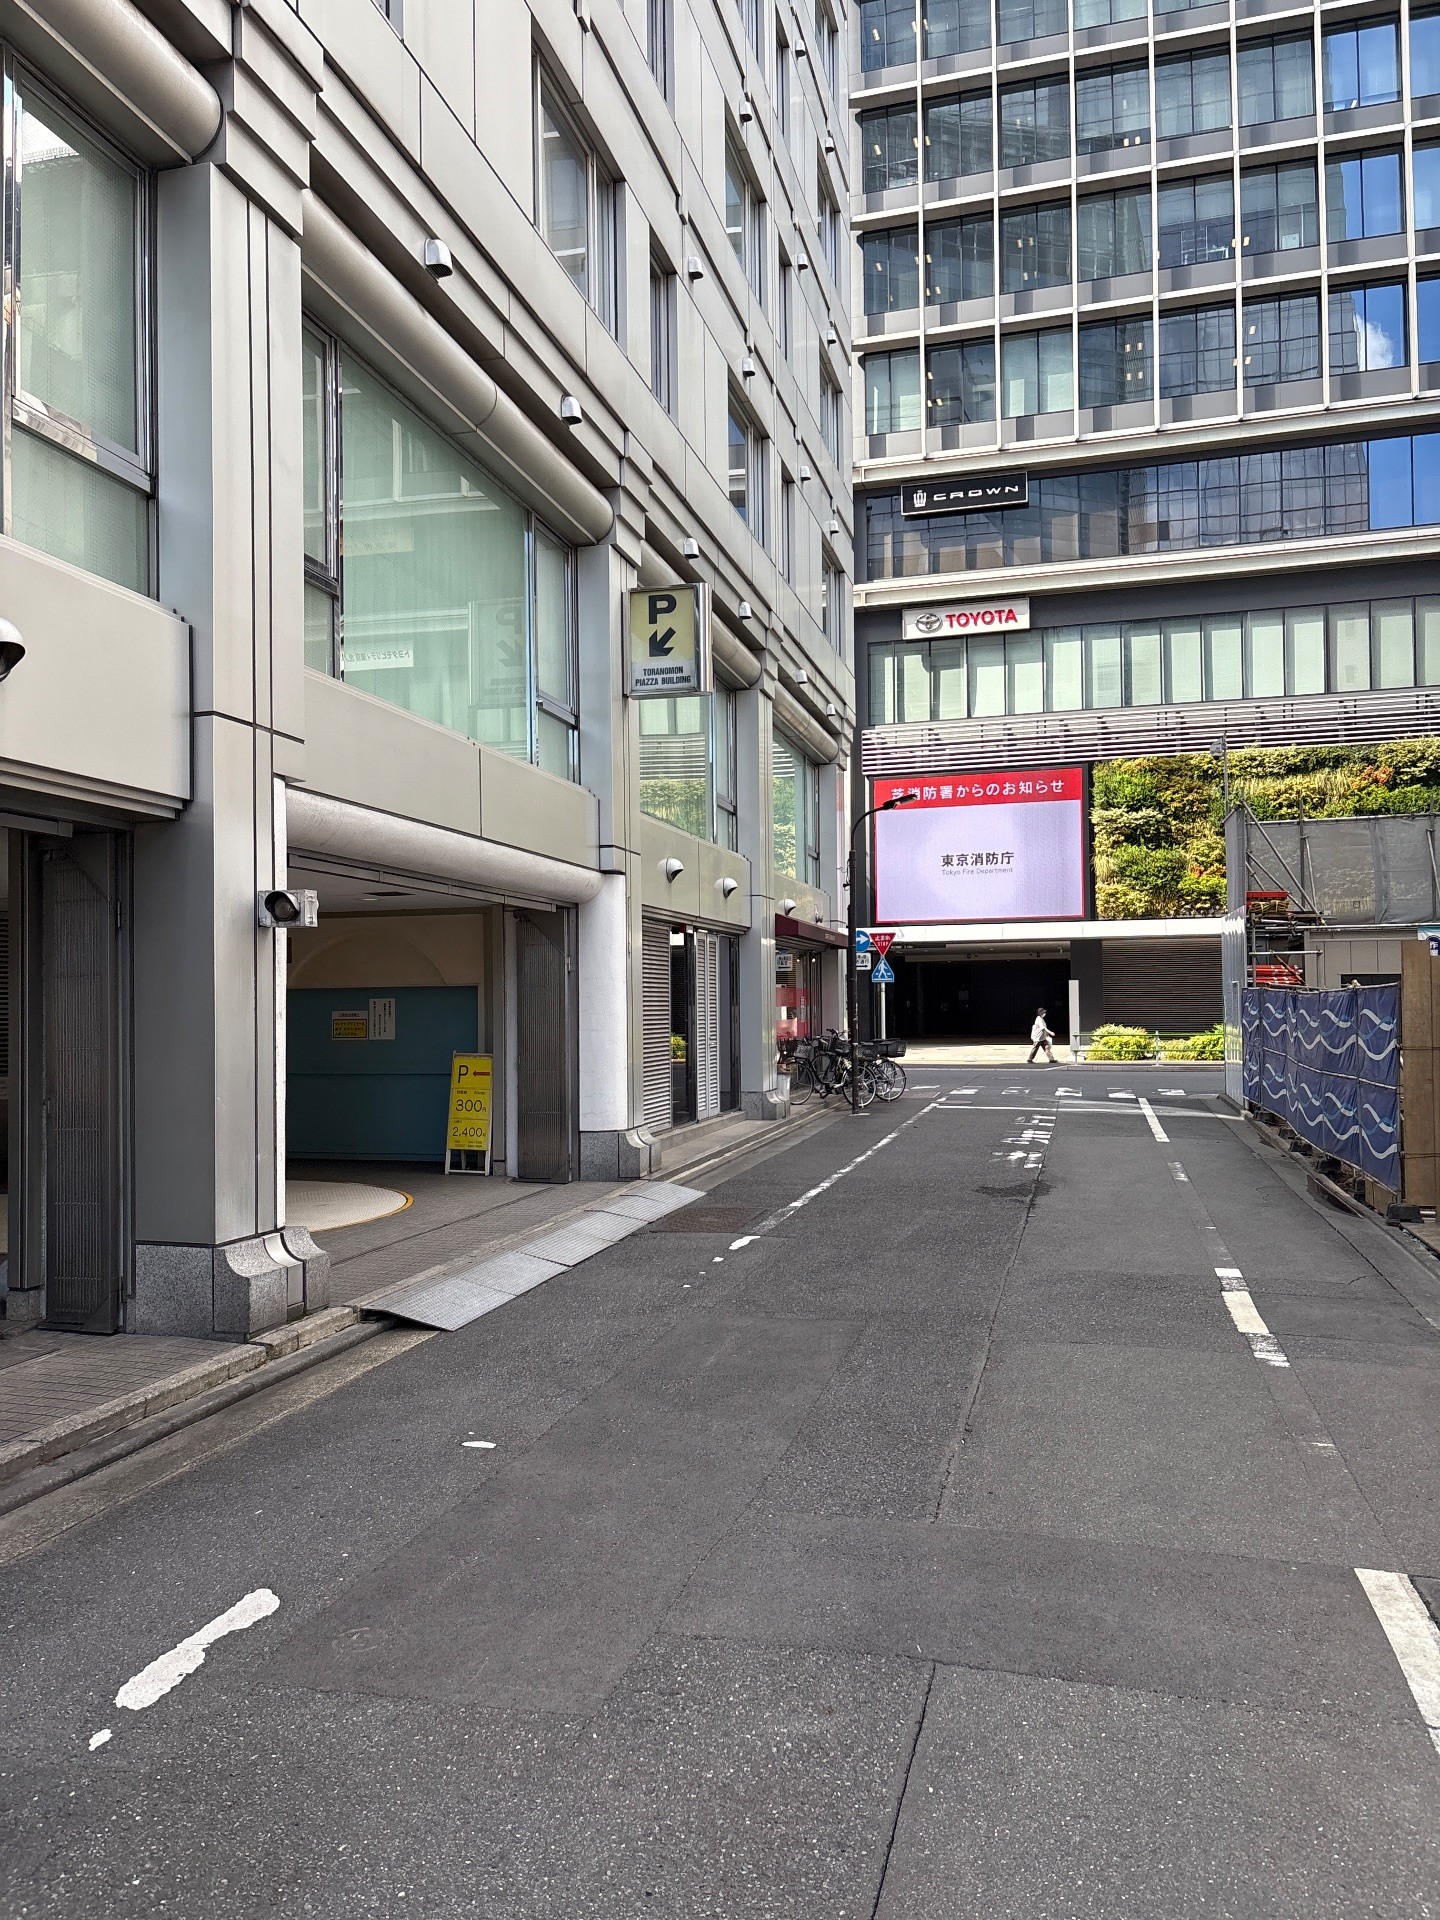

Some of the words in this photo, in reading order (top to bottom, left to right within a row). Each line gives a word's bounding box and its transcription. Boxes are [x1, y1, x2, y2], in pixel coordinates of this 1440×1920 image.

[933, 485, 1019, 501] CROWN
[648, 594, 677, 624] P
[945, 608, 1018, 629] TOYOTA
[643, 666, 684, 677] TORANOMON
[635, 678, 659, 687] PIAZZA
[661, 675, 691, 685] BUILDING
[891, 780, 1065, 801] 芝消防署からのお知らせ
[940, 851, 1015, 868] 東京消防庁
[976, 867, 1014, 875] Department
[457, 1065, 469, 1084] P
